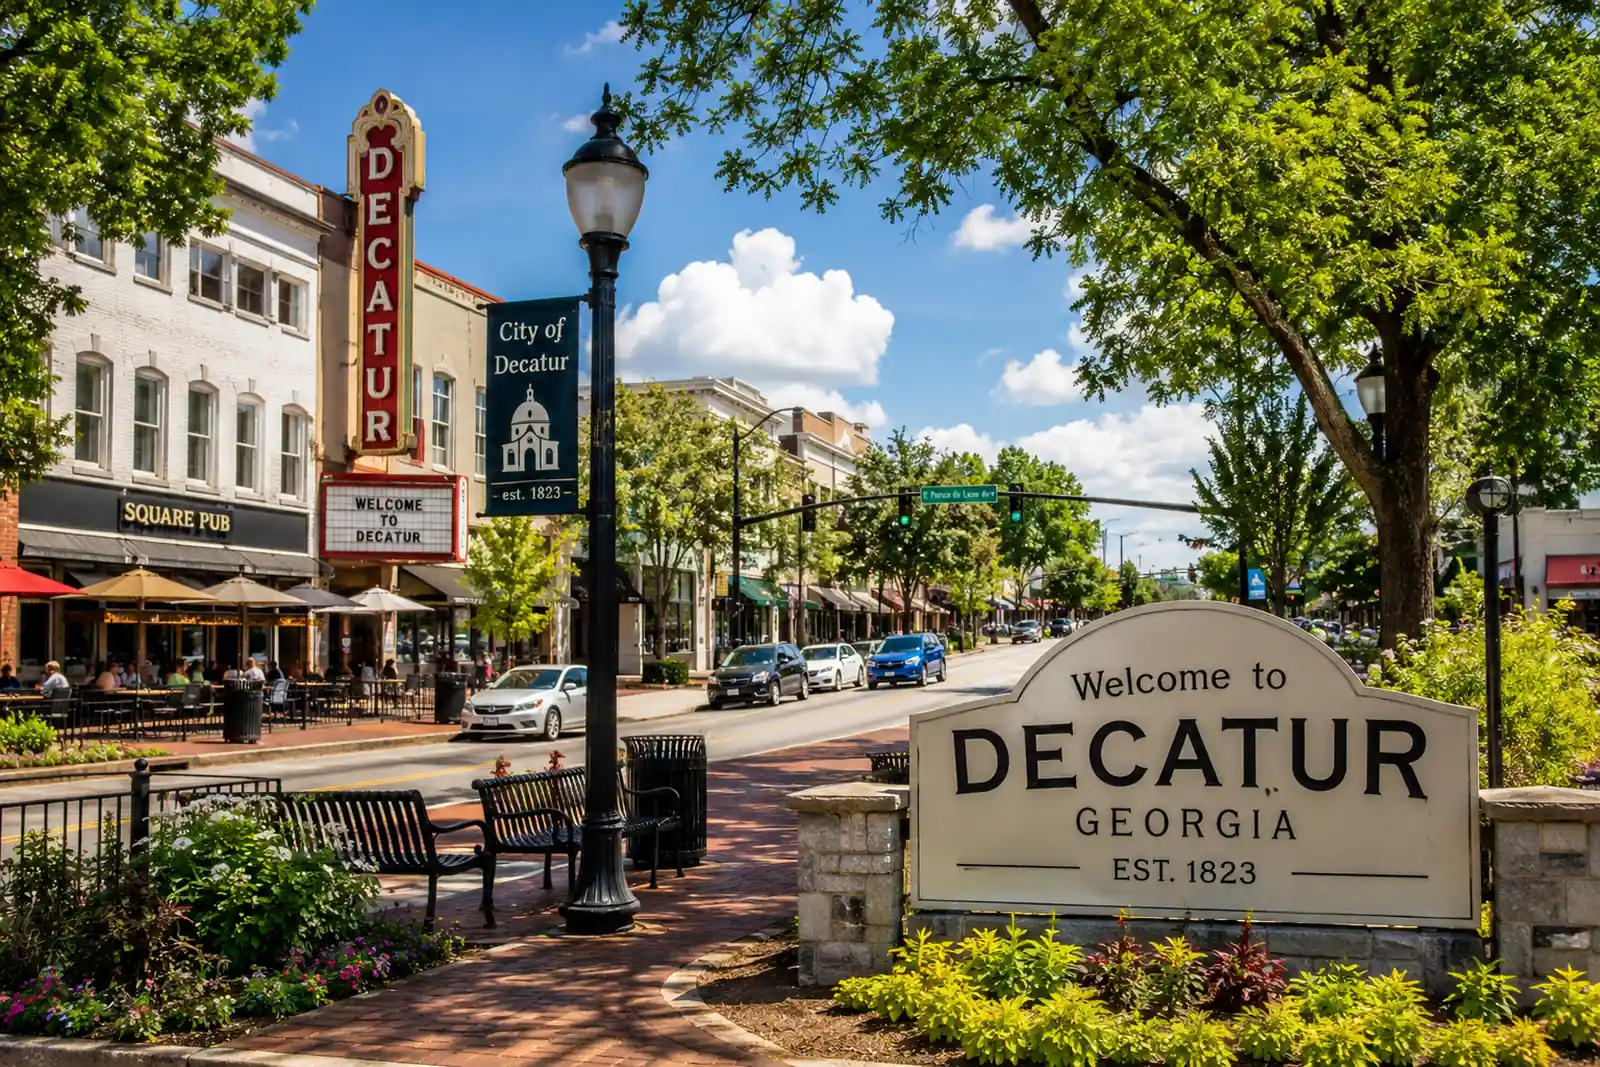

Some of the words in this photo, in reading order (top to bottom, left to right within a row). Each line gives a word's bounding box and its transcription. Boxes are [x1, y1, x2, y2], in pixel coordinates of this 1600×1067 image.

[365, 147, 393, 443] DECATUR
[499, 320, 539, 347] City
[544, 315, 567, 342] of
[493, 353, 569, 376] Decatur
[355, 497, 423, 511] WELCOME
[502, 488, 525, 501] est.
[529, 485, 560, 500] 1823
[124, 502, 195, 528] SQUARE
[199, 512, 230, 532] PUB
[380, 514, 398, 527] TO
[356, 530, 421, 544] DECATUR
[1071, 666, 1231, 701] Welcome
[1252, 662, 1287, 691] to
[952, 716, 1428, 801] DECATUR
[1075, 806, 1298, 841] GEORGIA
[1112, 858, 1177, 884] EST.
[1186, 859, 1257, 886] 1823
